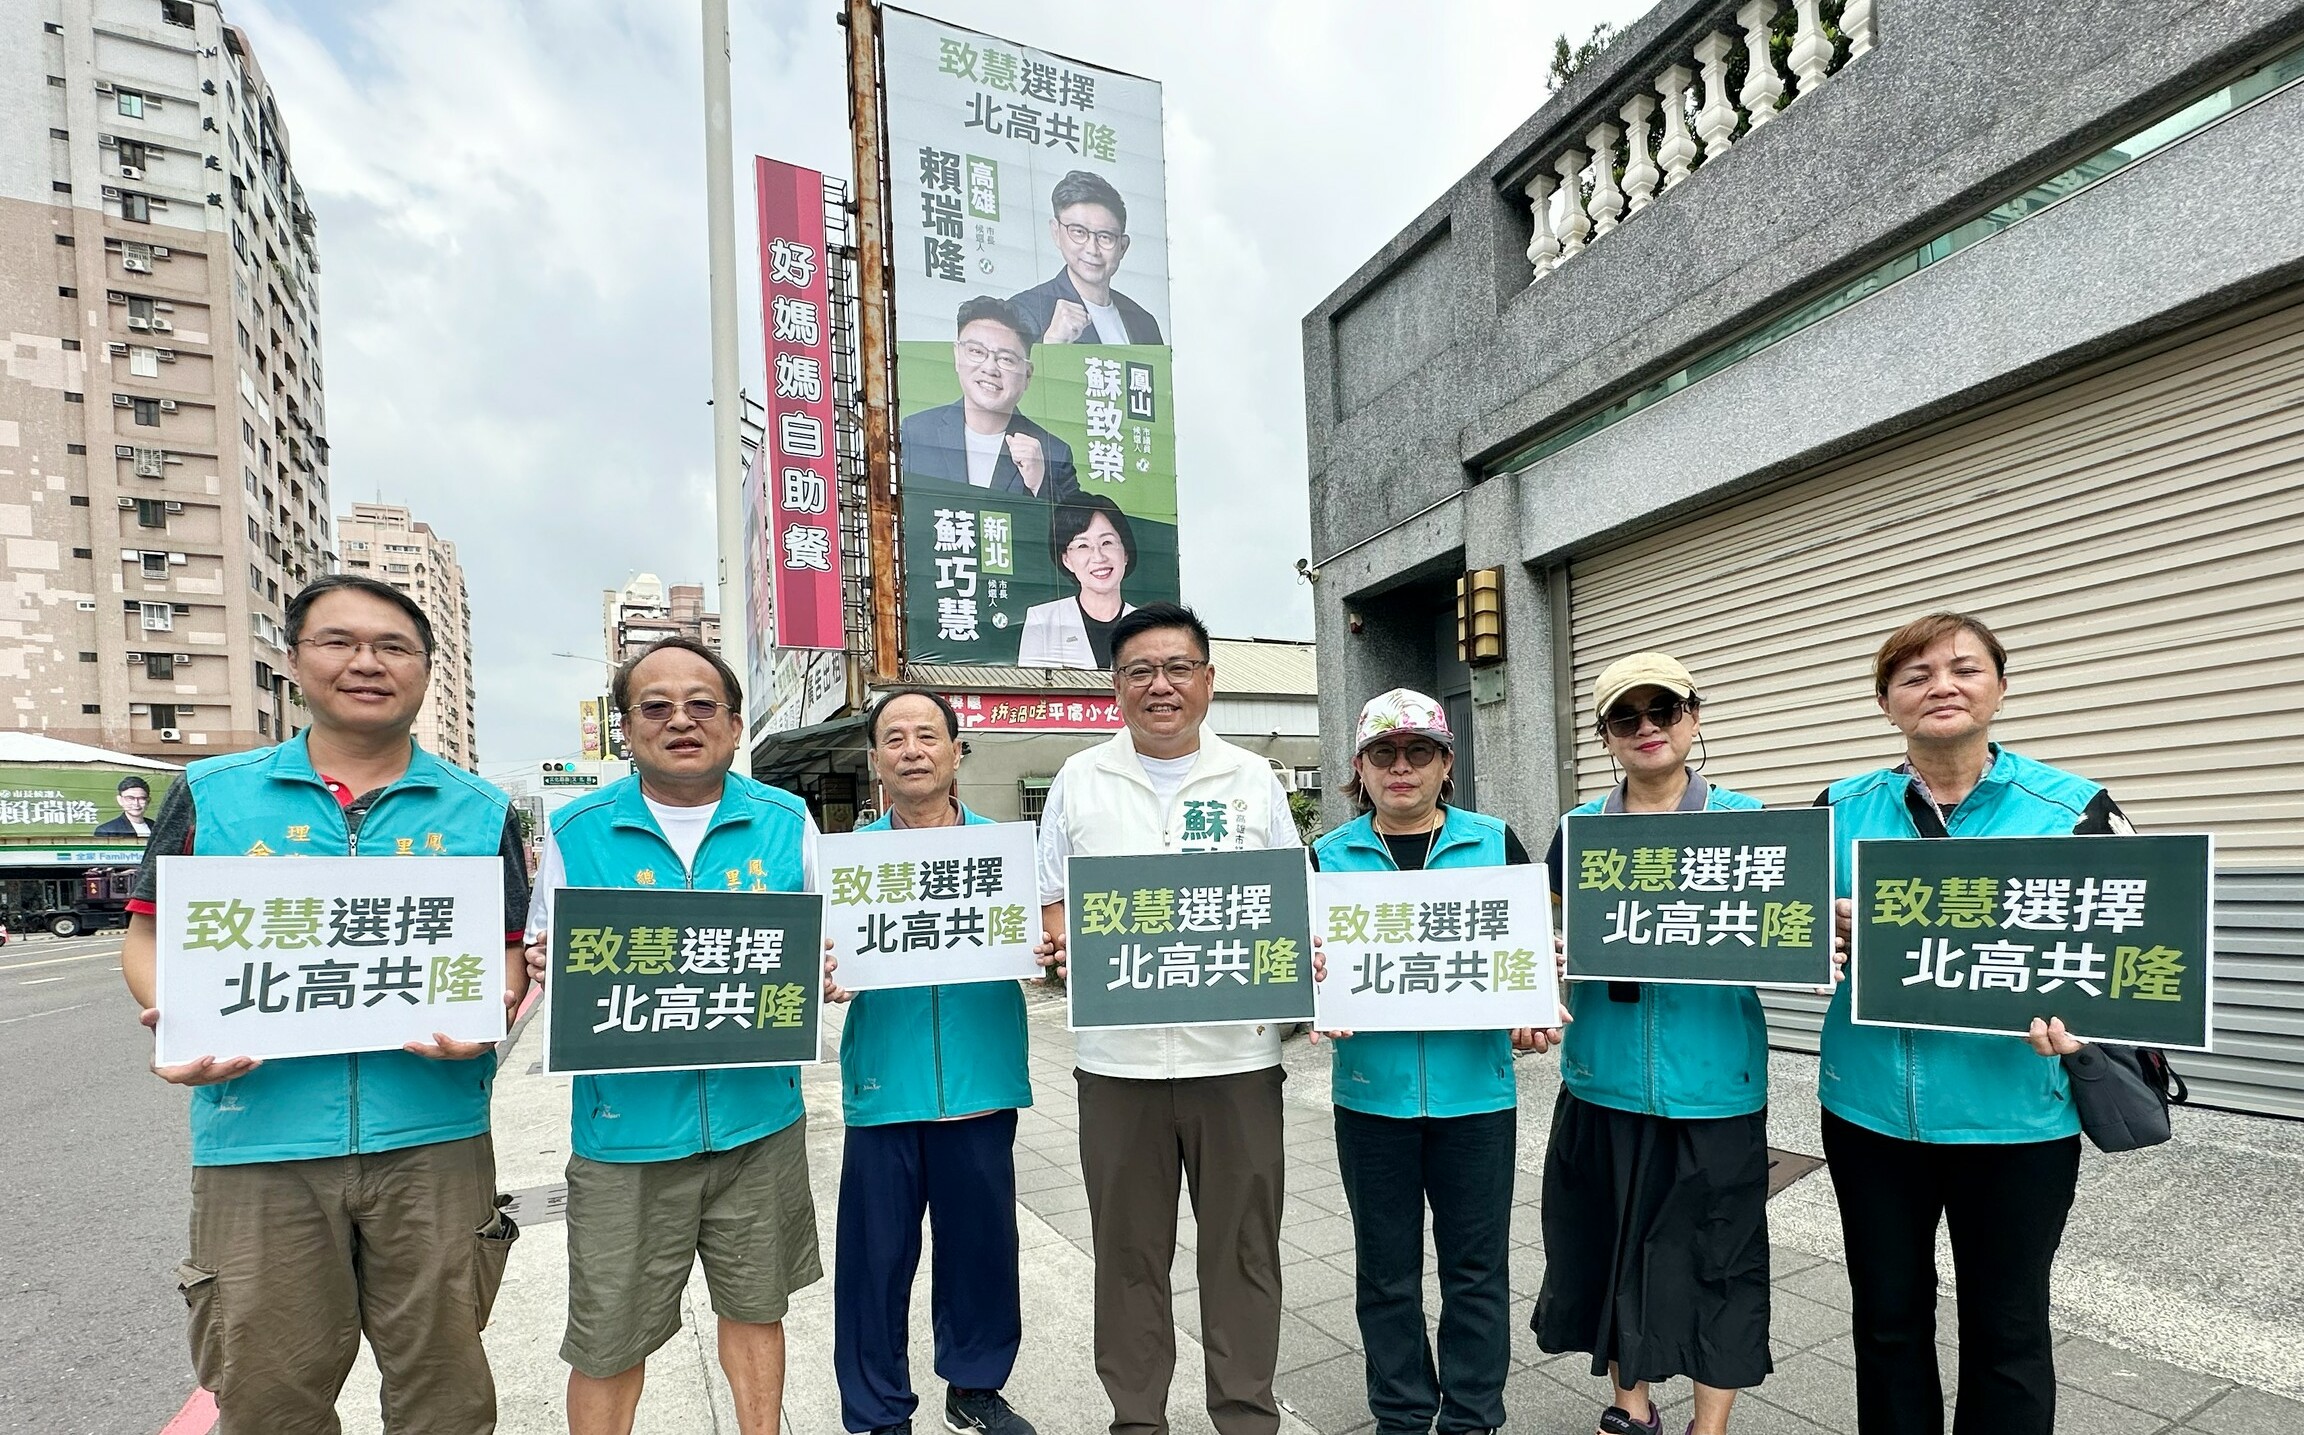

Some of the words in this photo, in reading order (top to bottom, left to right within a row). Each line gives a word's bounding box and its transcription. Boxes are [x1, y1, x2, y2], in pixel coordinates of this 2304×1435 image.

[938, 37, 1094, 112] 致慧選擇
[964, 93, 1118, 163] 北高共隆
[969, 161, 997, 216] 高雄
[918, 146, 966, 284] 賴瑞隆
[770, 238, 831, 570] 好媽媽自助餐
[1129, 368, 1152, 417] 鳳山
[1084, 357, 1126, 483] 蘇致榮
[983, 516, 1010, 568] 新北
[933, 508, 980, 641] 蘇巧慧
[999, 580, 1008, 599] 市長
[0, 800, 99, 825] 賴瑞隆
[13, 790, 64, 798] 市長候選人
[425, 833, 446, 855] 鳳
[1181, 800, 1228, 851] 蘇
[1235, 815, 1246, 850] 高雄市
[100, 853, 143, 862] FamilyMa
[725, 869, 742, 889] 里
[831, 856, 1003, 906] 致慧選擇
[1578, 846, 1786, 892] 致慧選擇
[183, 896, 455, 952] 致慧選擇
[856, 904, 1027, 955] 北高共隆
[1081, 884, 1271, 936] 致慧選擇
[1327, 900, 1510, 944] 致慧選擇
[1602, 899, 1816, 950] 北高共隆
[1872, 876, 2147, 932] 致慧選擇
[566, 926, 784, 975] 致慧選擇
[1105, 937, 1298, 991] 北高共隆
[1351, 948, 1538, 996] 北高共隆
[1901, 938, 2186, 1002] 北高共隆
[220, 953, 485, 1016] 北高共隆
[592, 982, 807, 1034] 北高共隆
